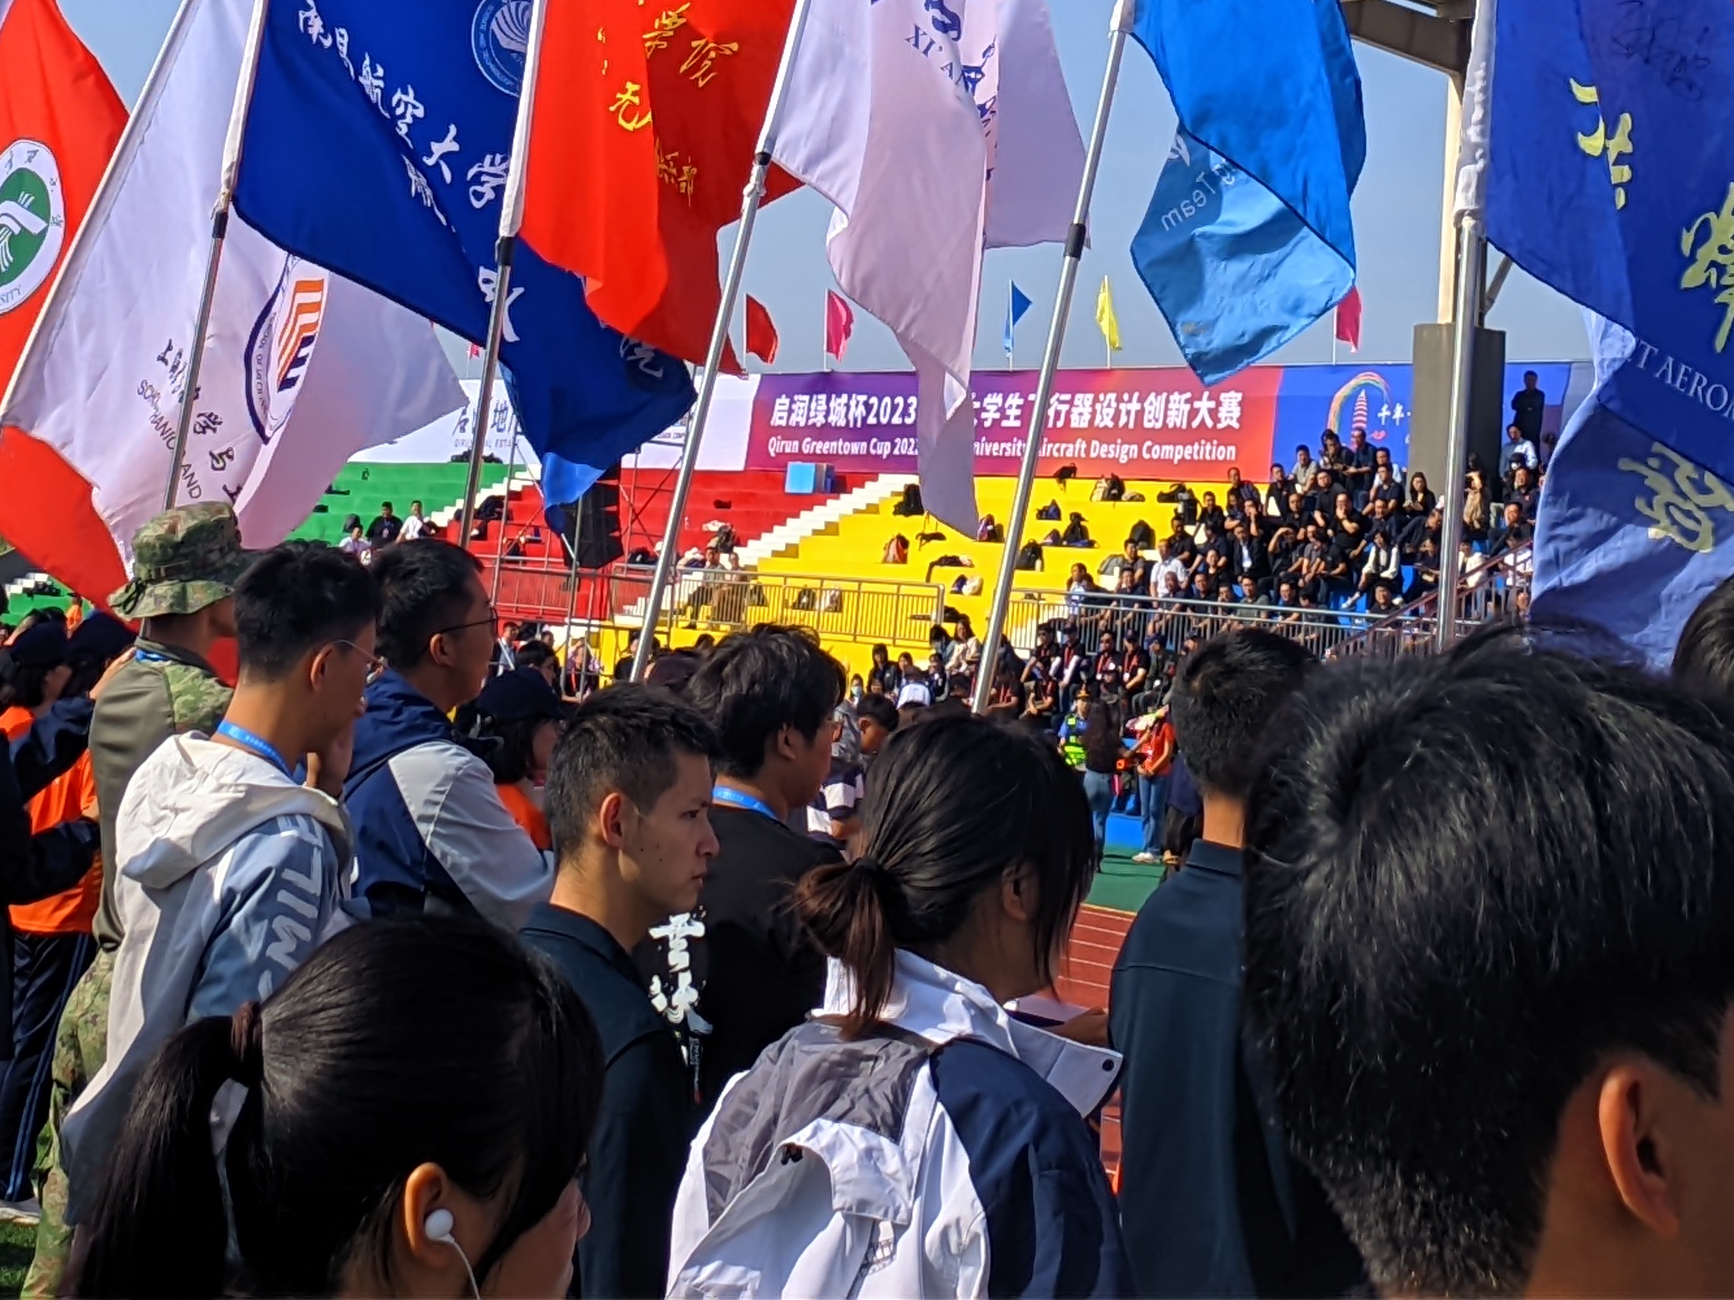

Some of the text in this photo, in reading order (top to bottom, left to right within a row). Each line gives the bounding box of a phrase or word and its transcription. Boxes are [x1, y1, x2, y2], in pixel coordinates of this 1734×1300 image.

[767, 435, 799, 457] Qirun
[802, 436, 867, 456] Greentown
[869, 437, 891, 458] Cup
[1090, 439, 1137, 463] Design
[1142, 440, 1236, 464] Competition
[181, 463, 203, 500] AND
